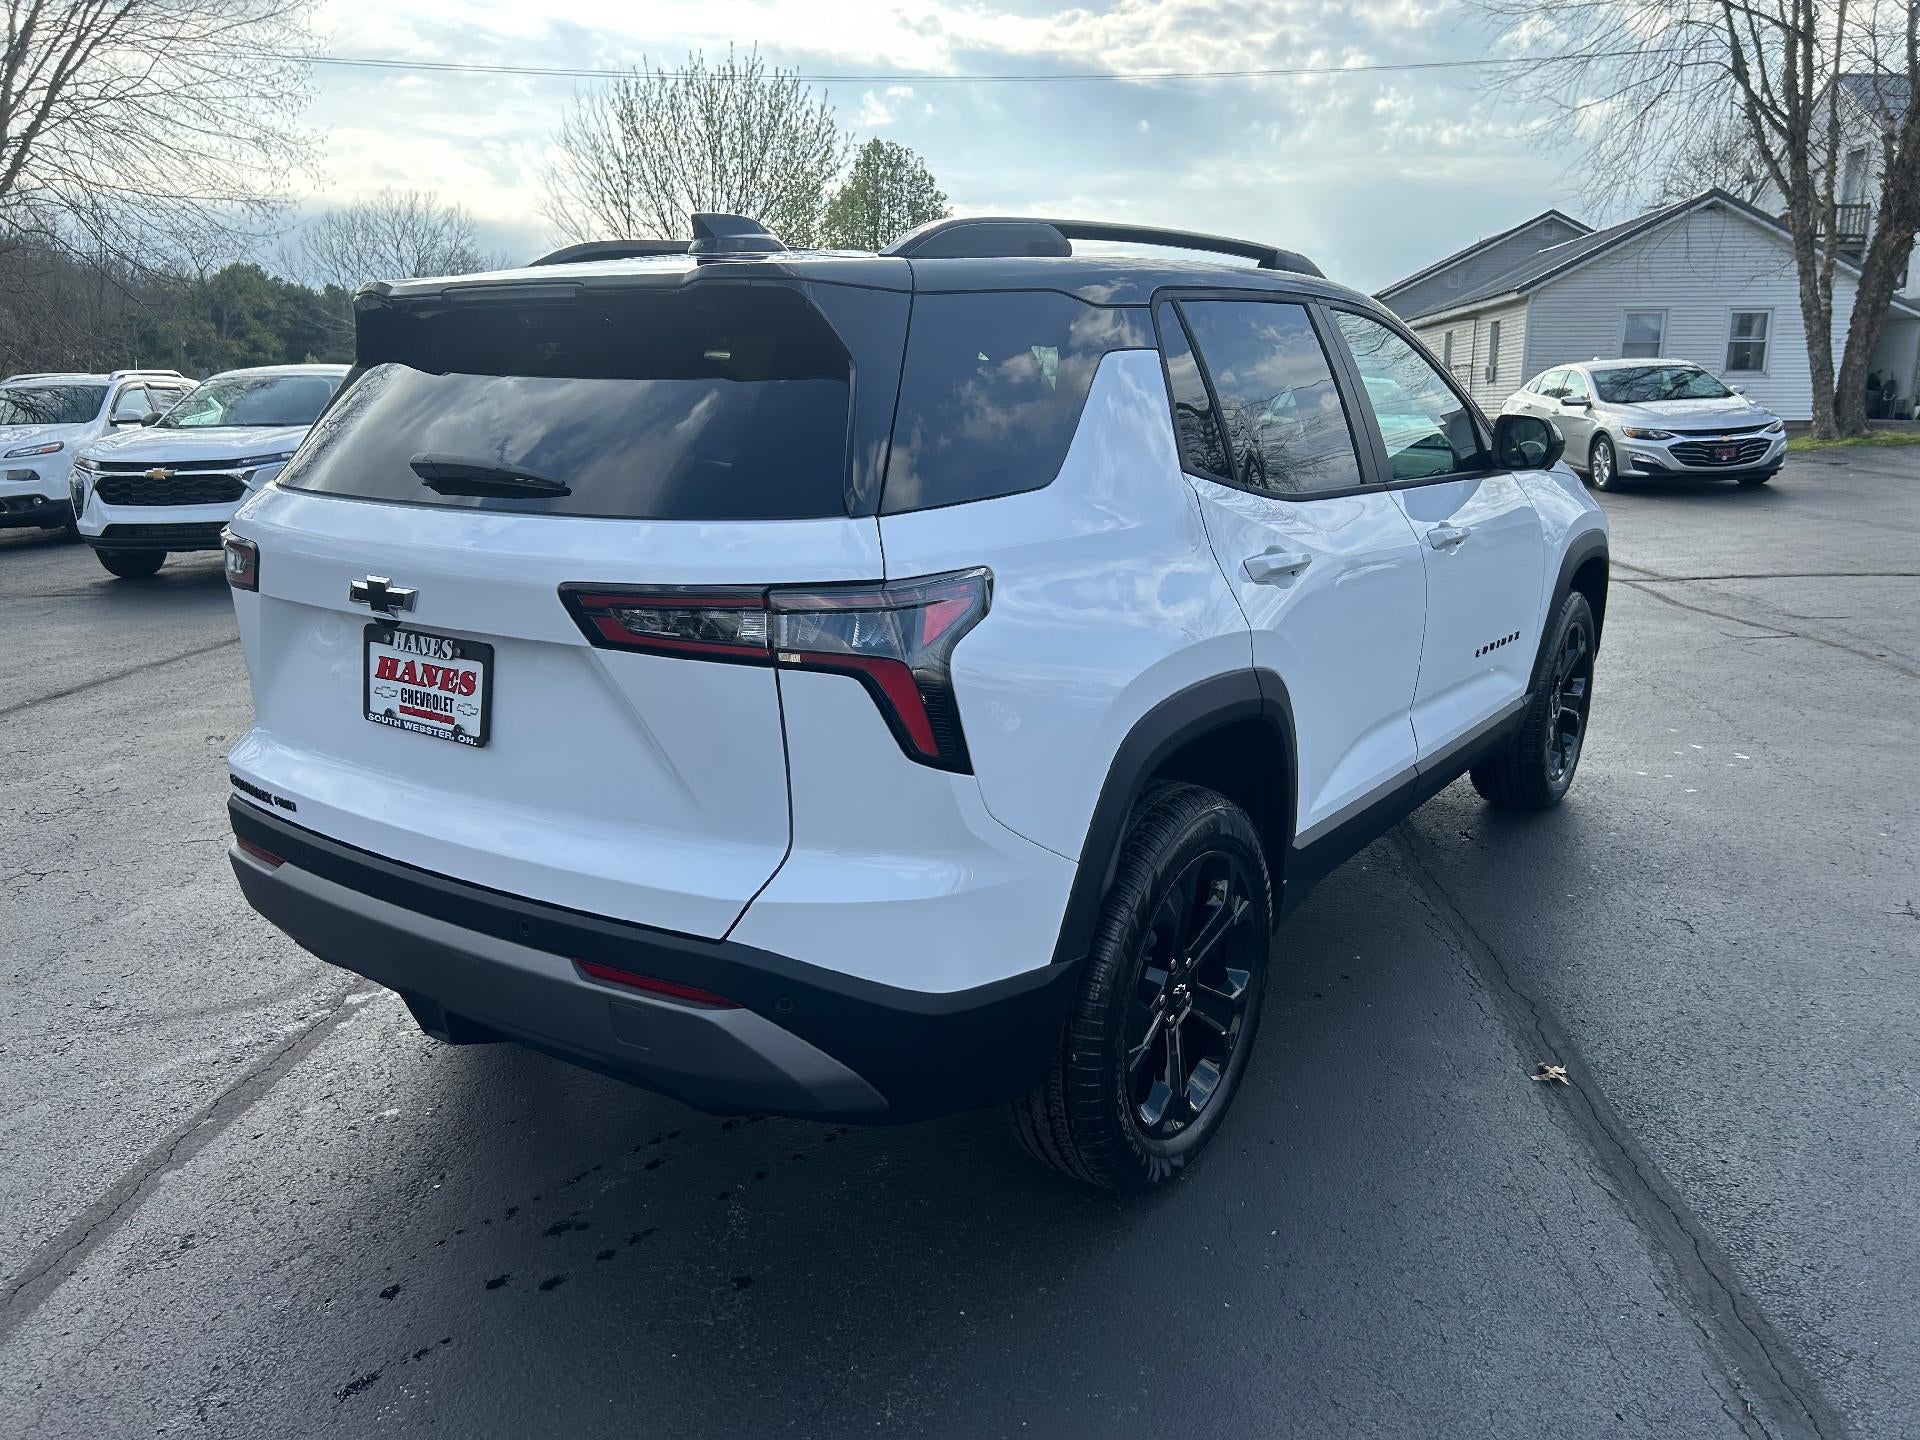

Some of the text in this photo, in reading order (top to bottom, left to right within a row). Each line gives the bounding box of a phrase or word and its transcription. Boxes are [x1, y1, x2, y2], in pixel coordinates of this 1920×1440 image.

[392, 630, 454, 660] HANES
[375, 655, 477, 697] HANES
[400, 687, 455, 713] CHEVROLET
[368, 713, 401, 728] SOUTH
[403, 719, 455, 741] WEBSTER,
[457, 733, 477, 746] OH.
